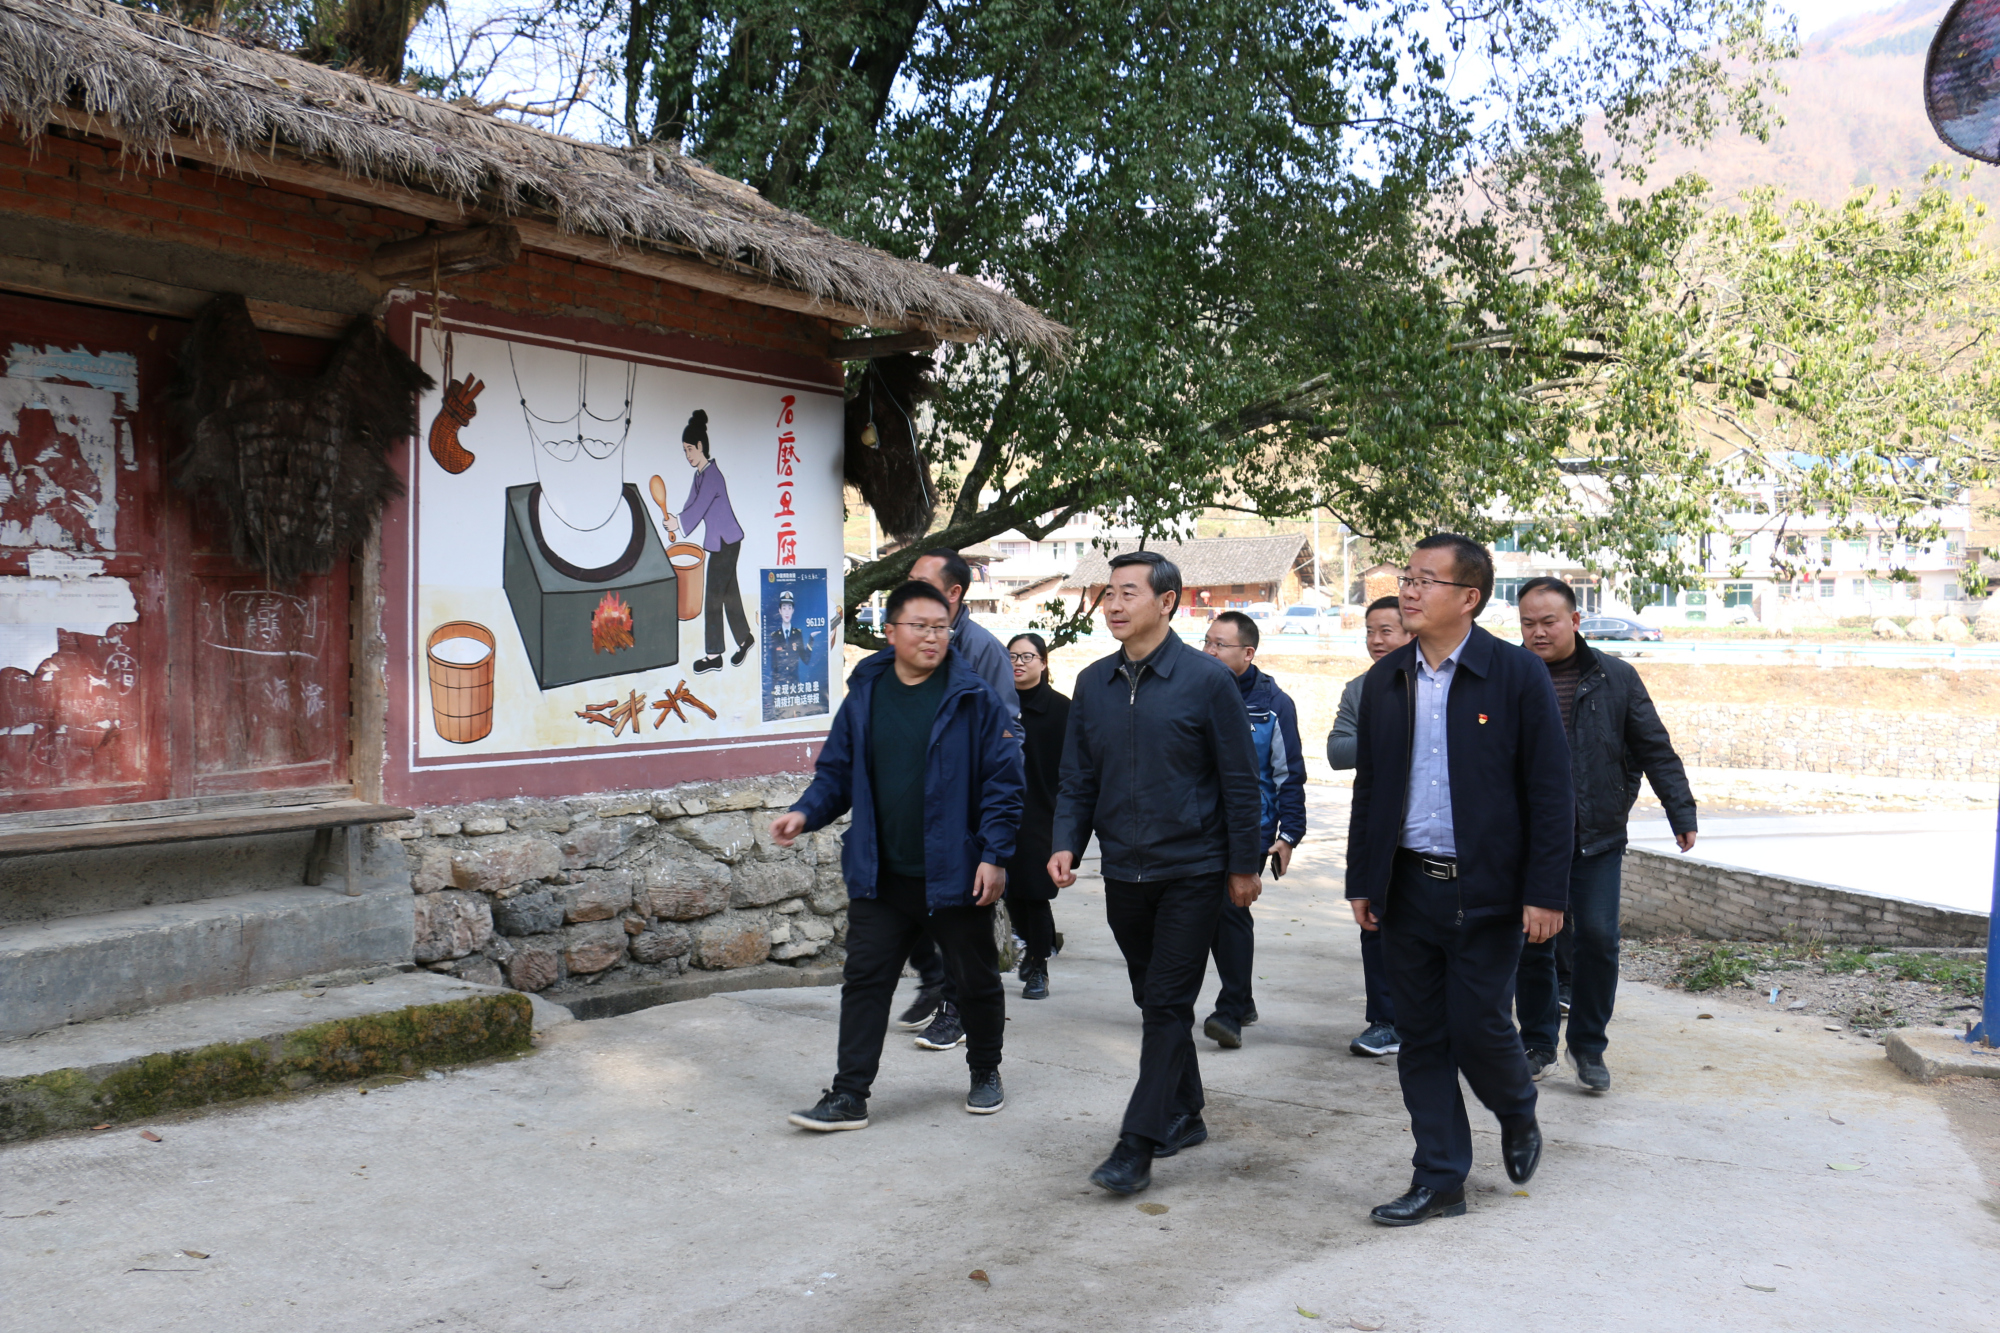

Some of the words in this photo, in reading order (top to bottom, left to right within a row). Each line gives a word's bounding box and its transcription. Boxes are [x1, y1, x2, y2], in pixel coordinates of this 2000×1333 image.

[805, 617, 825, 627] 96119
[774, 681, 819, 695] 发现火灾隐患
[774, 693, 819, 708] 请拨打电话举报
